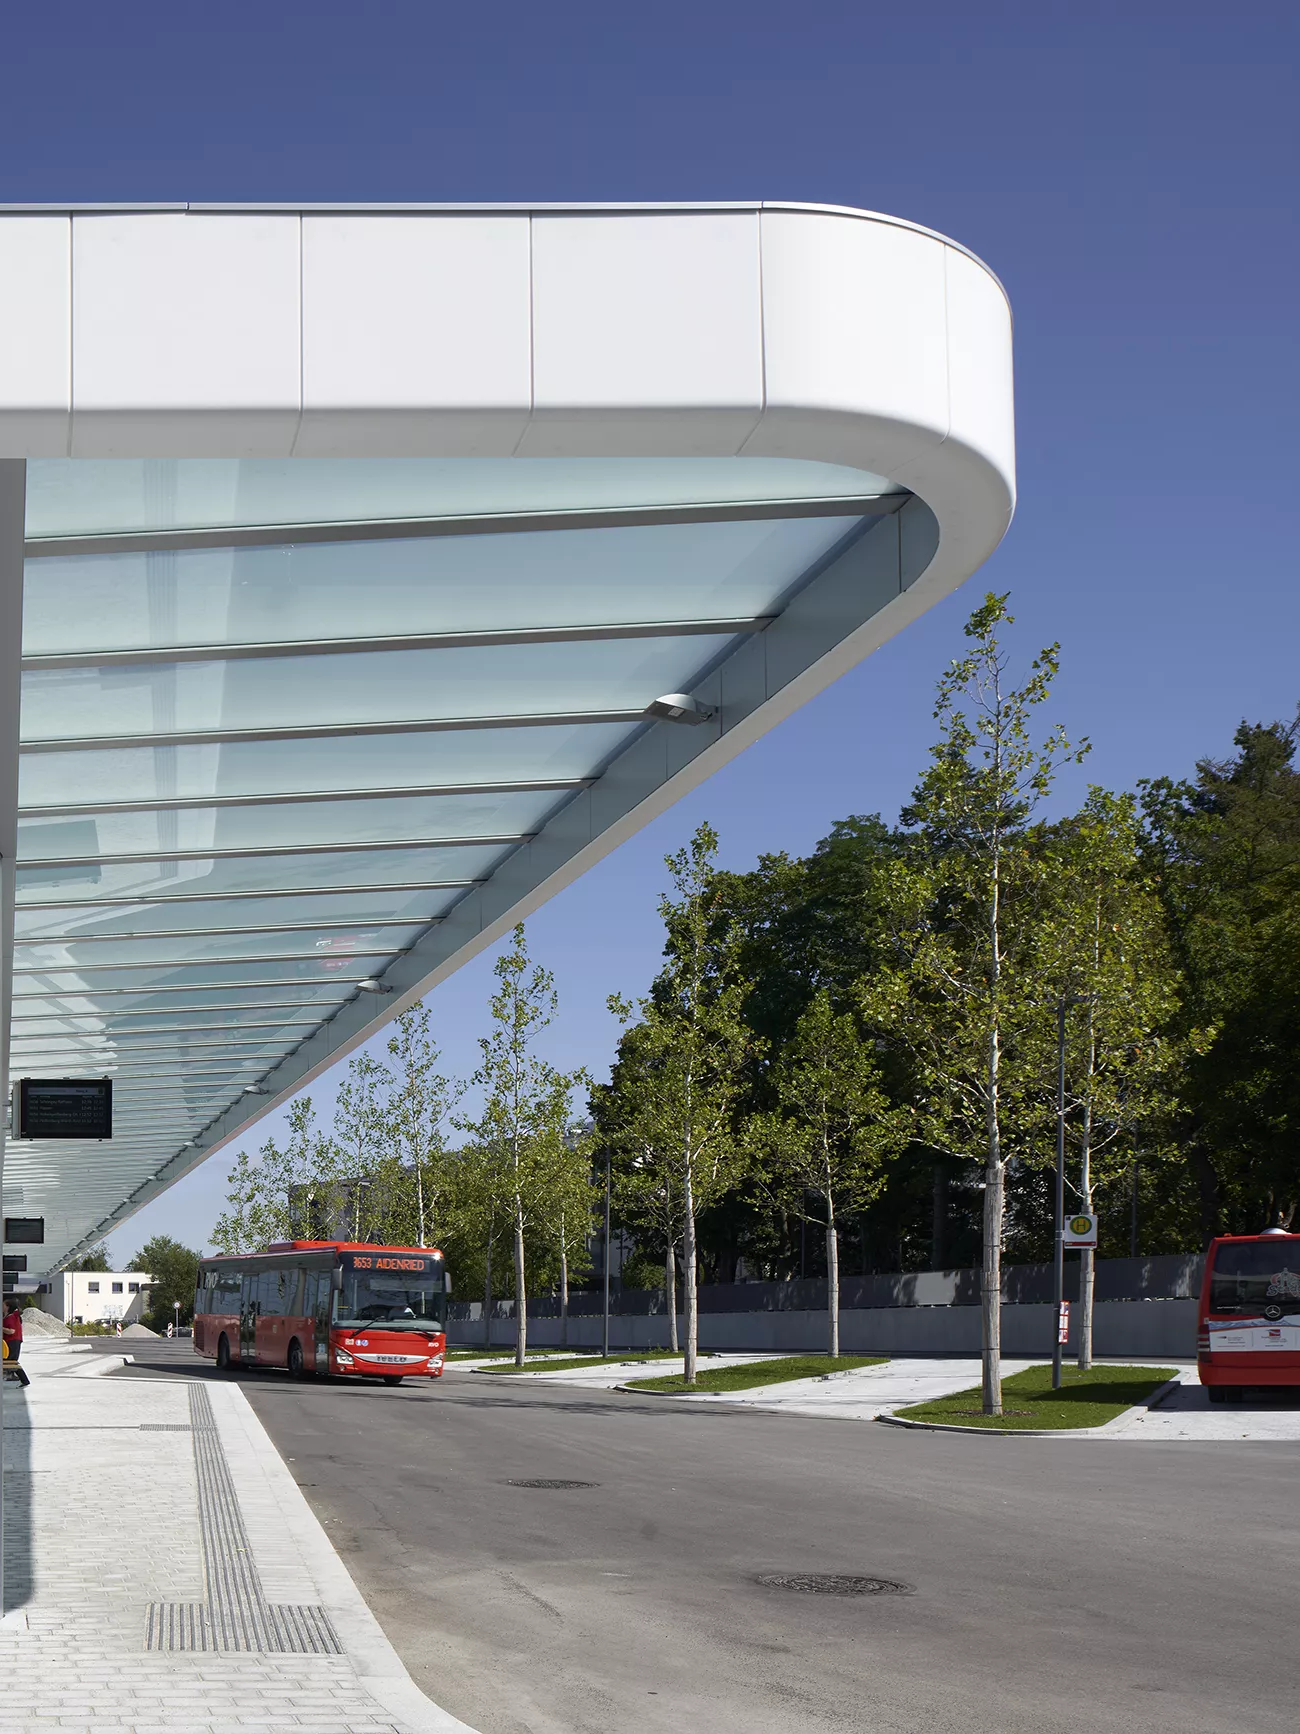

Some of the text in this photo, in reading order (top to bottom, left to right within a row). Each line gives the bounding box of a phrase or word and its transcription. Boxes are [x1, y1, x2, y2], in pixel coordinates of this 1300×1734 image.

[1076, 1220, 1086, 1231] H
[353, 1256, 425, 1271] 3653 AIDENRIED
[376, 1355, 408, 1363] IVECO
